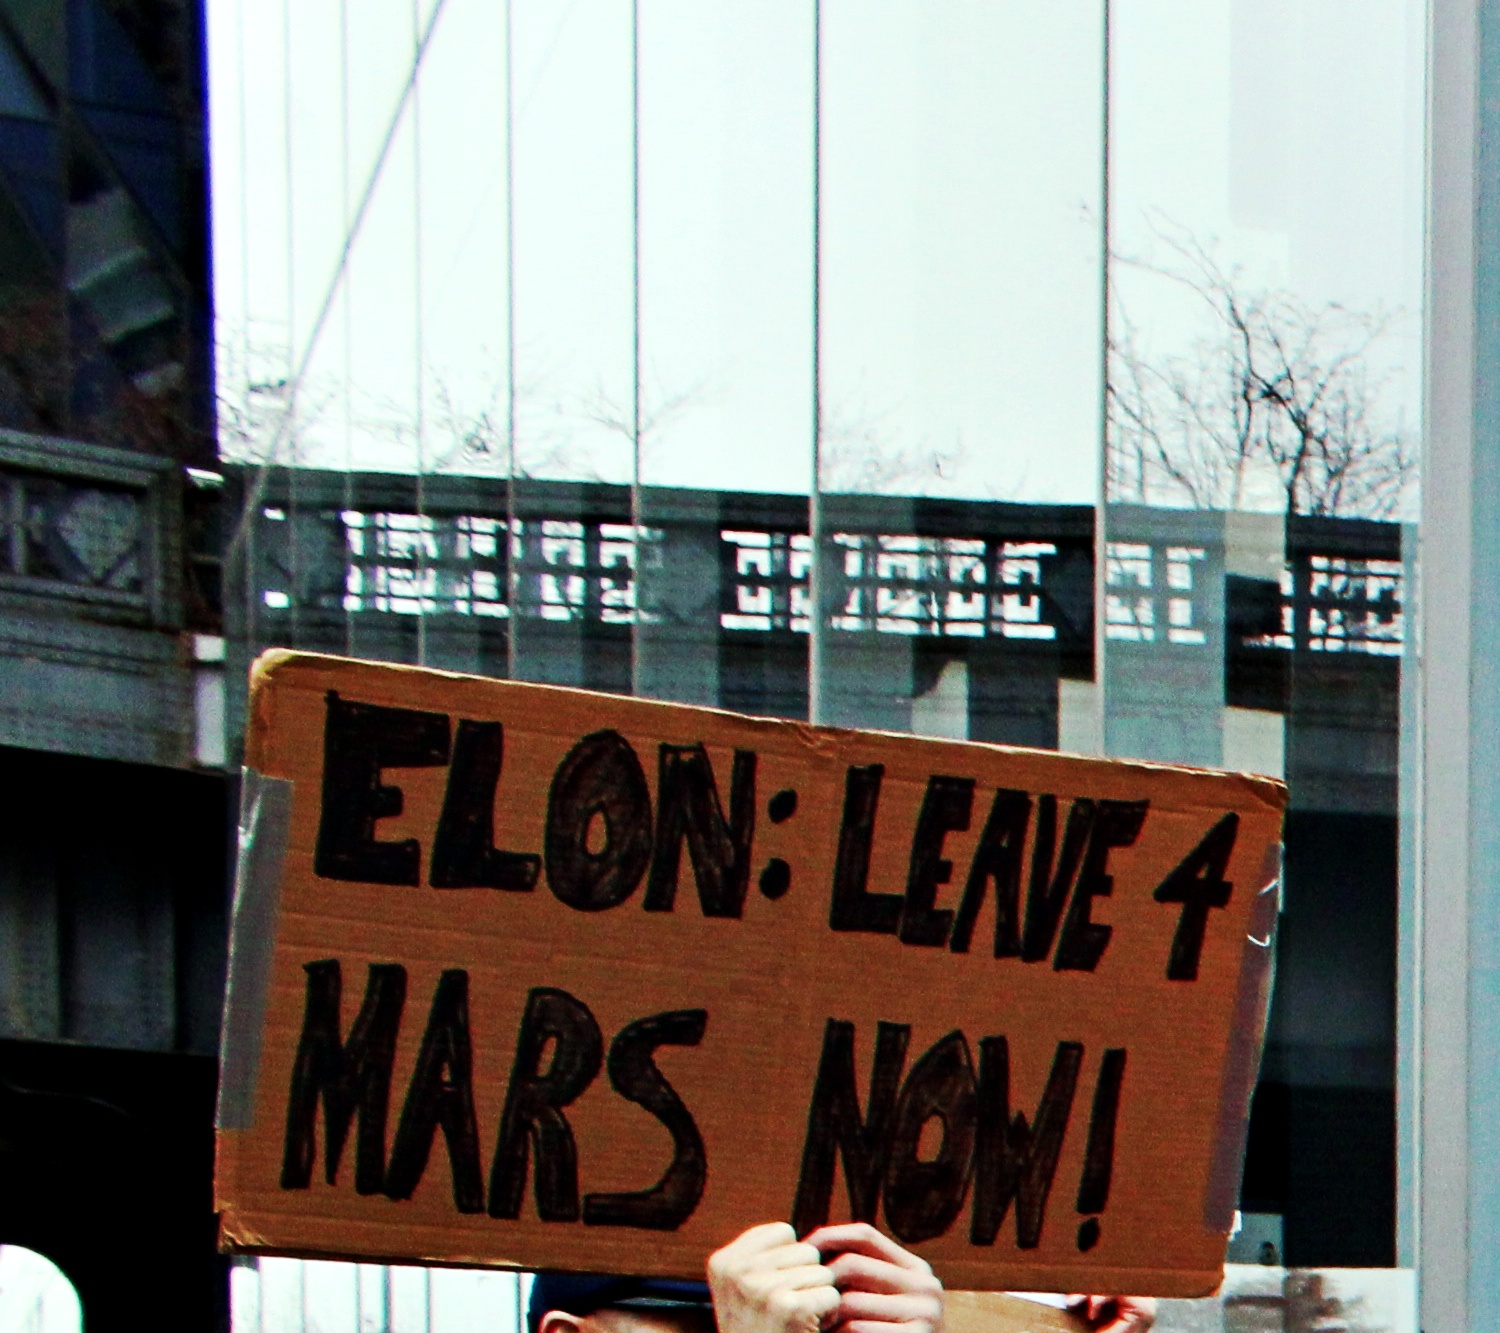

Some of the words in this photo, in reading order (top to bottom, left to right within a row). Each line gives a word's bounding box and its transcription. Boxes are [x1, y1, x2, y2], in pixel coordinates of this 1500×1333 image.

[313, 689, 799, 920] ELON:
[829, 762, 1150, 972] LEAVE
[1153, 811, 1241, 982] 4
[280, 957, 710, 1232] MARS
[793, 1017, 1127, 1254] NOW!
